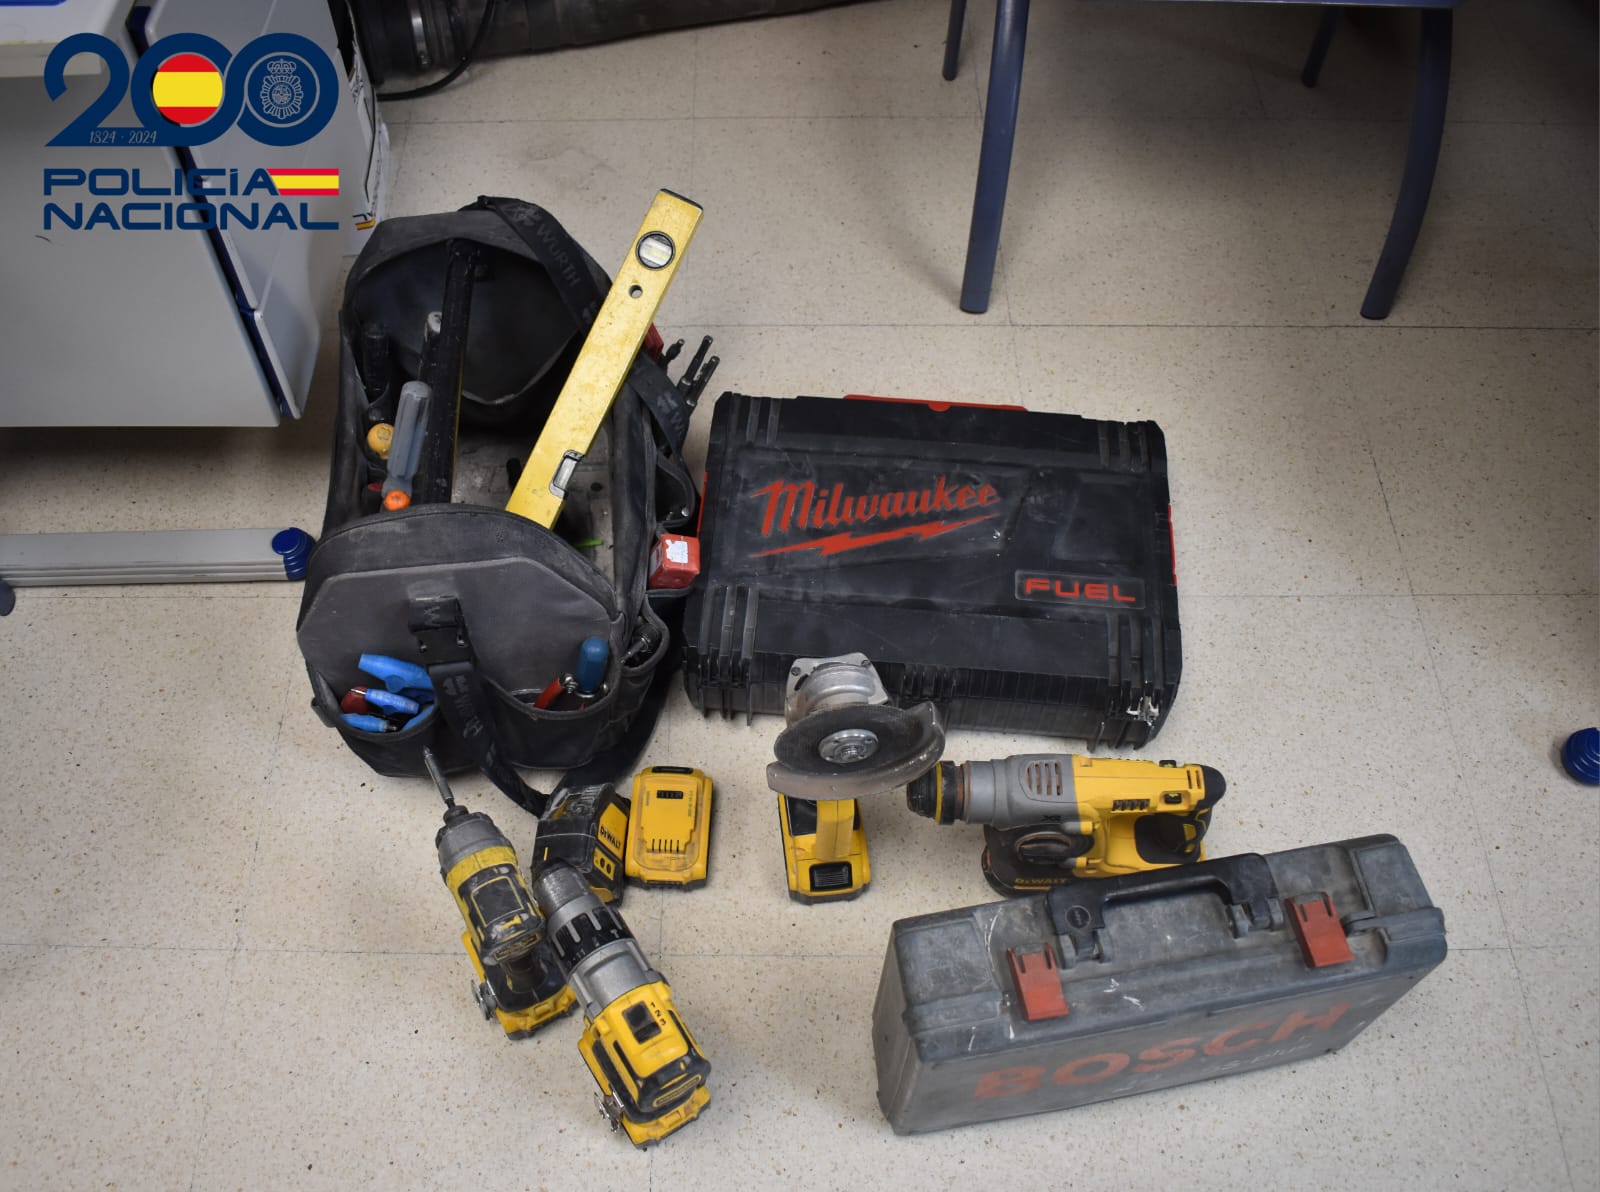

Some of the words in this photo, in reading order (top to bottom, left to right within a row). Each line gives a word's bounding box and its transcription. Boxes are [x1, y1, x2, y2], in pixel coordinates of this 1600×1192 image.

[751, 475, 1001, 537] Milwaukee
[1024, 578, 1137, 603] FUEL
[974, 1003, 1353, 1100] BOSCH
